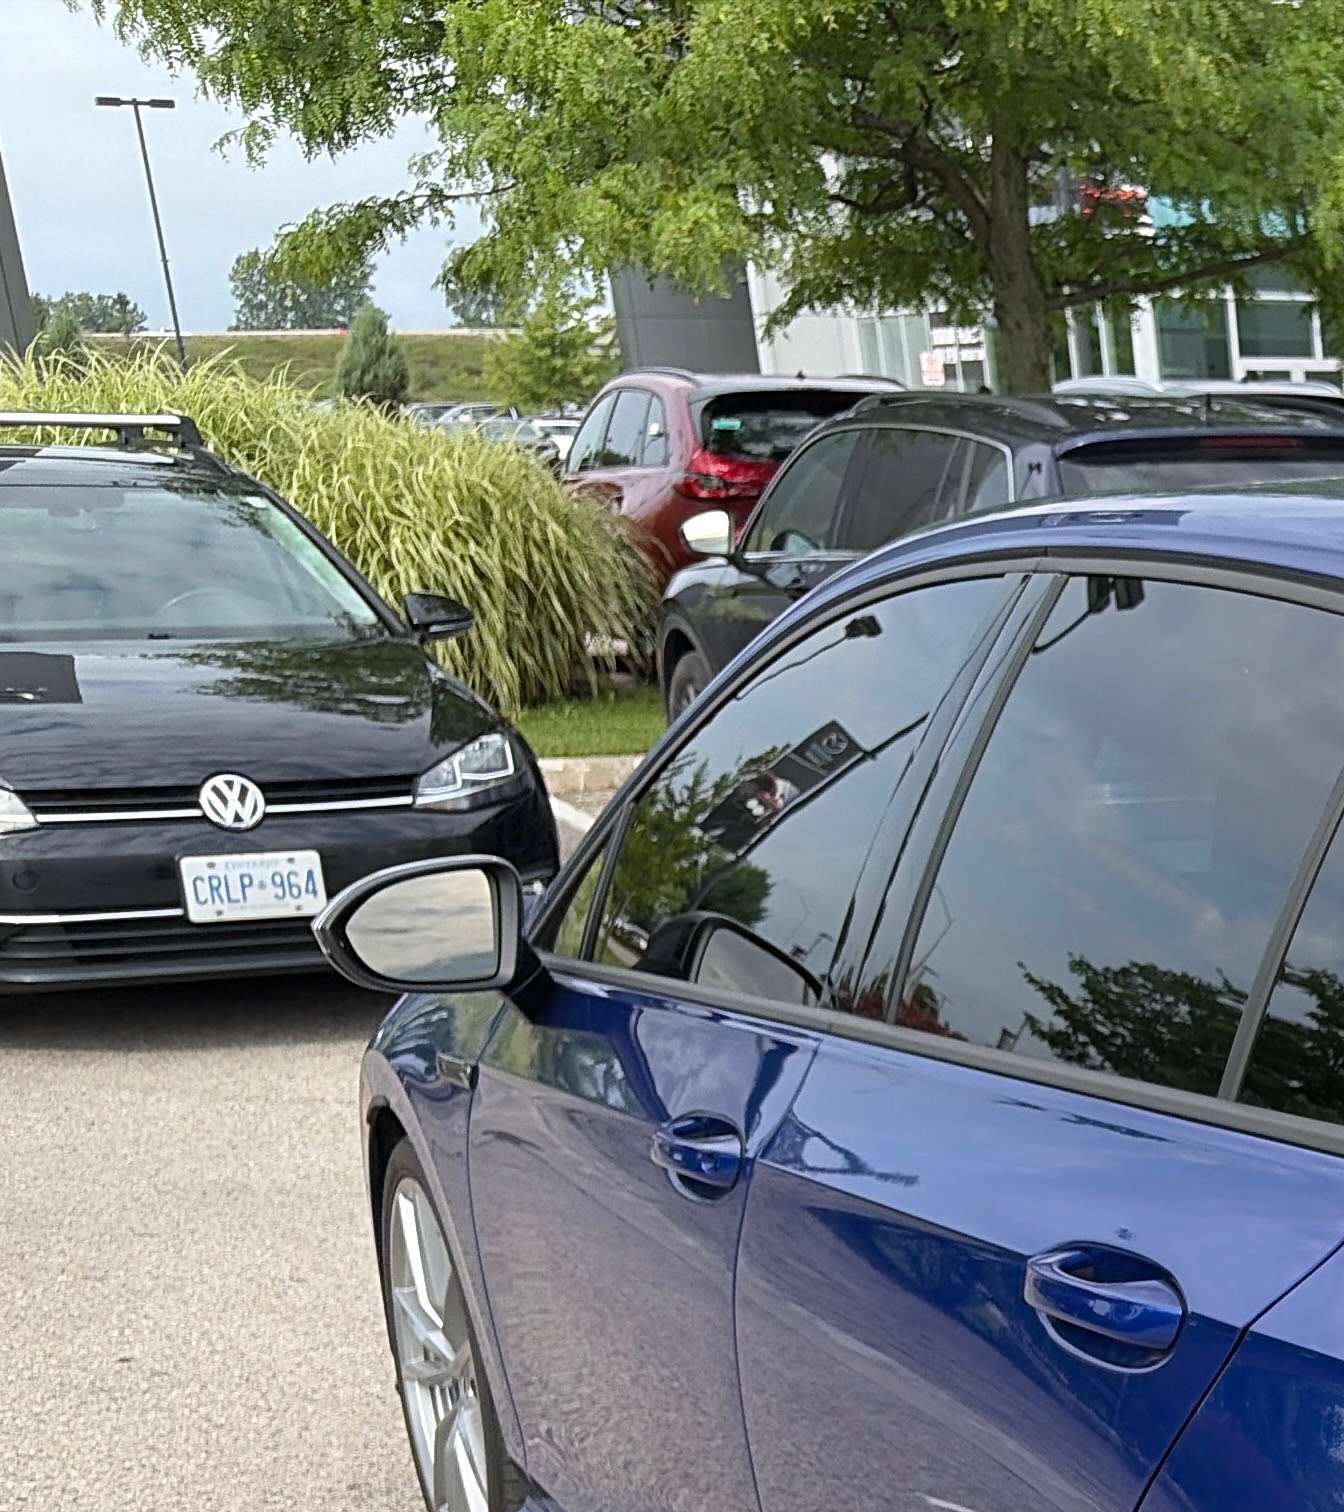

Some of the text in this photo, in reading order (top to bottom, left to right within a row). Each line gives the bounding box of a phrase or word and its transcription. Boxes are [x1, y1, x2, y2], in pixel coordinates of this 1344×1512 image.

[199, 773, 266, 829] VW
[192, 869, 319, 906] CRLP 964
